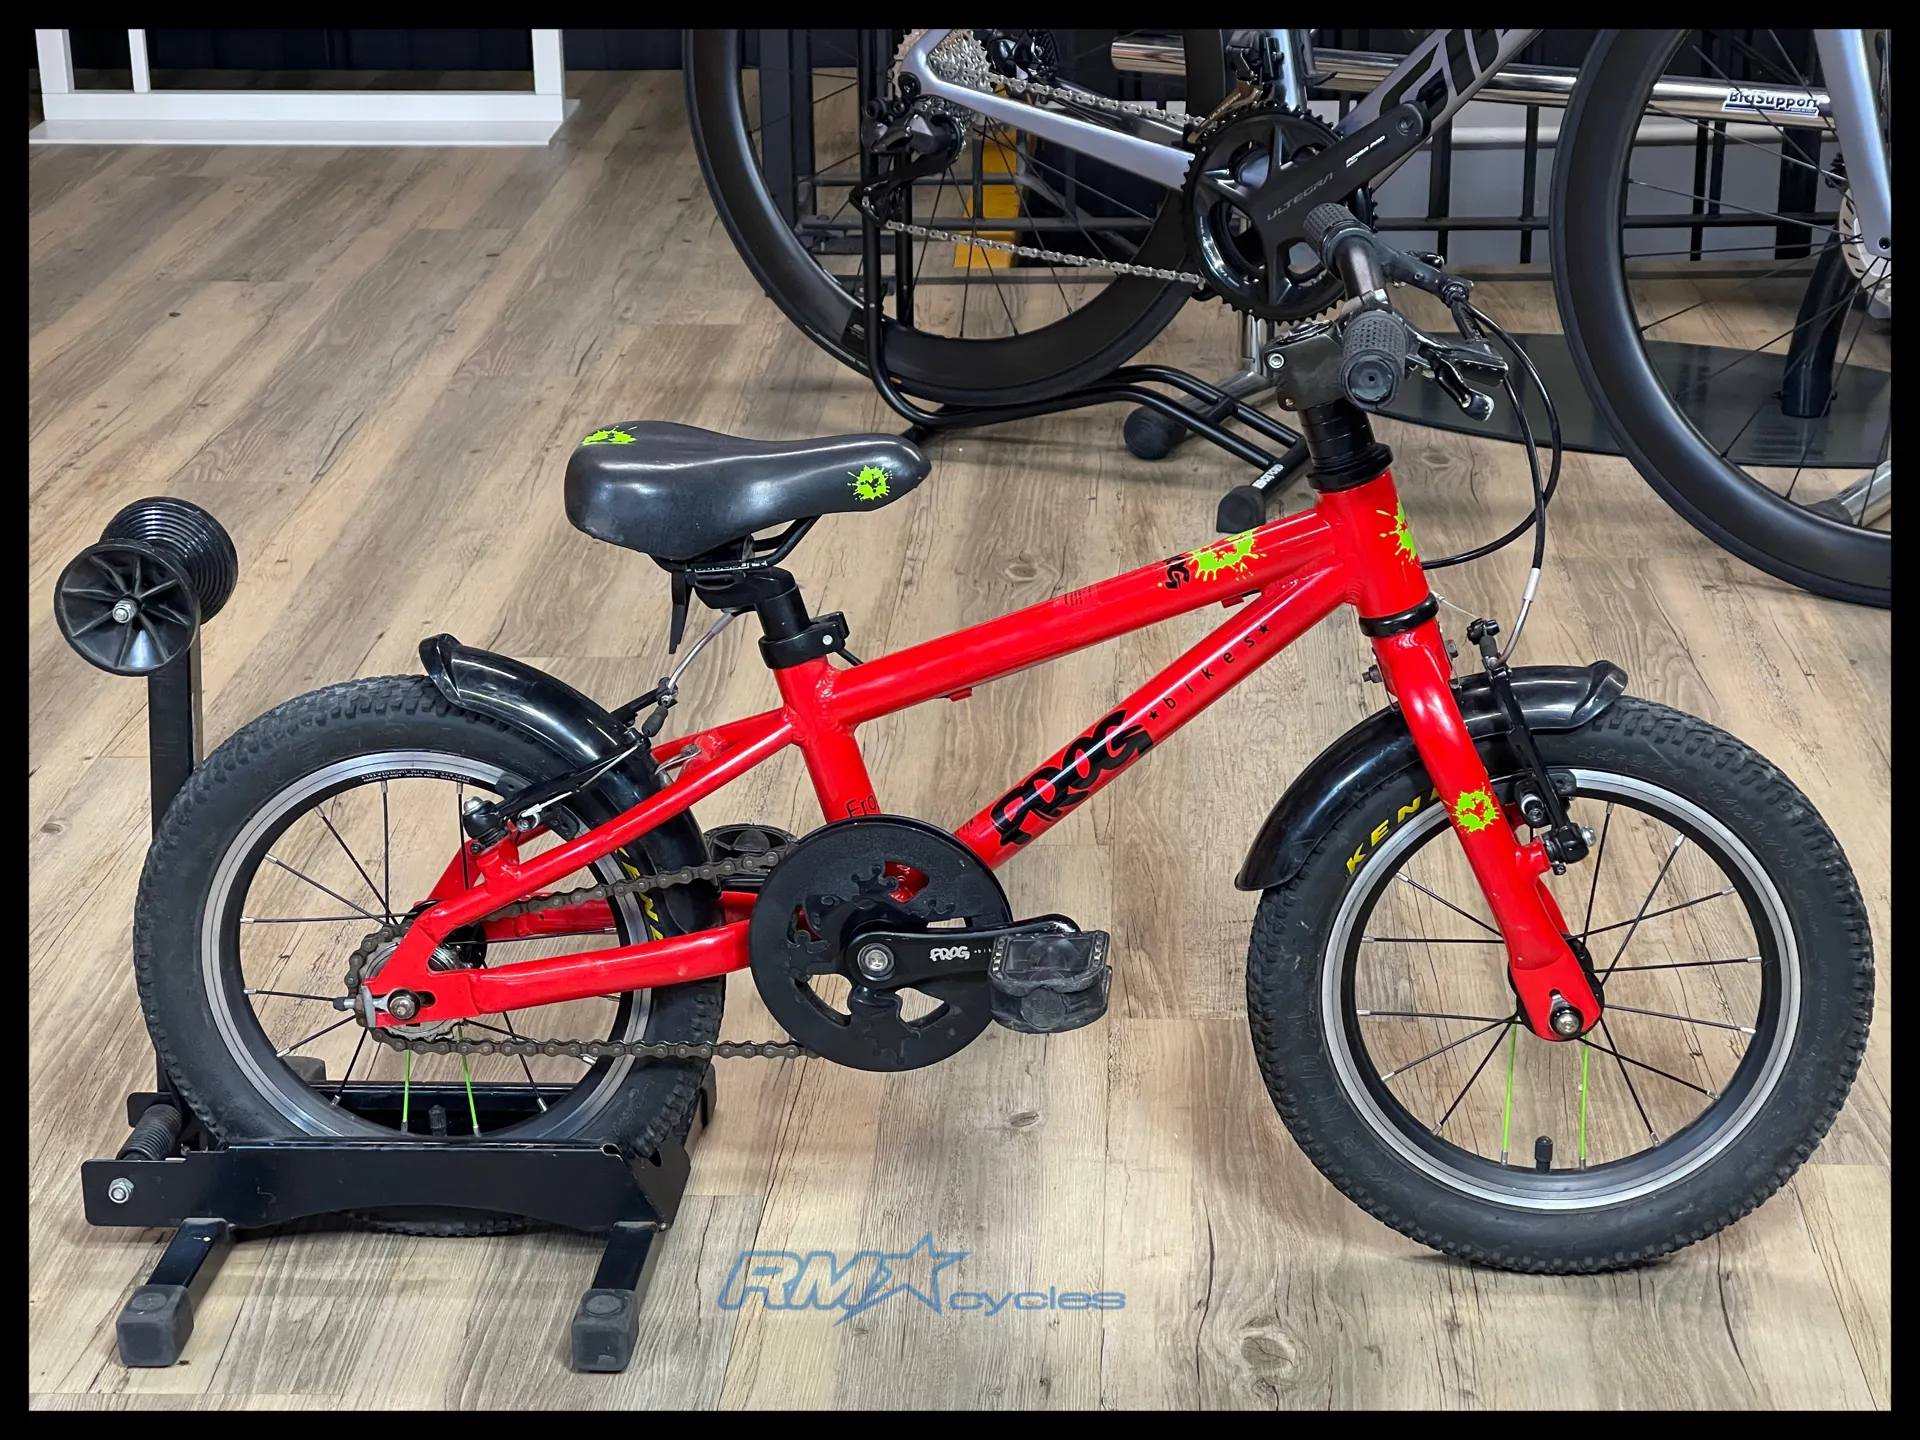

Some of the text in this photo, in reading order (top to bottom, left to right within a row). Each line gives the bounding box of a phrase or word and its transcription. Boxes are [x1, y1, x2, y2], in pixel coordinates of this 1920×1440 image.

[1266, 171, 1334, 221] ULTEGRA
[1162, 635, 1257, 710] bikes
[989, 709, 1154, 846] FROG
[929, 946, 971, 962] FROG
